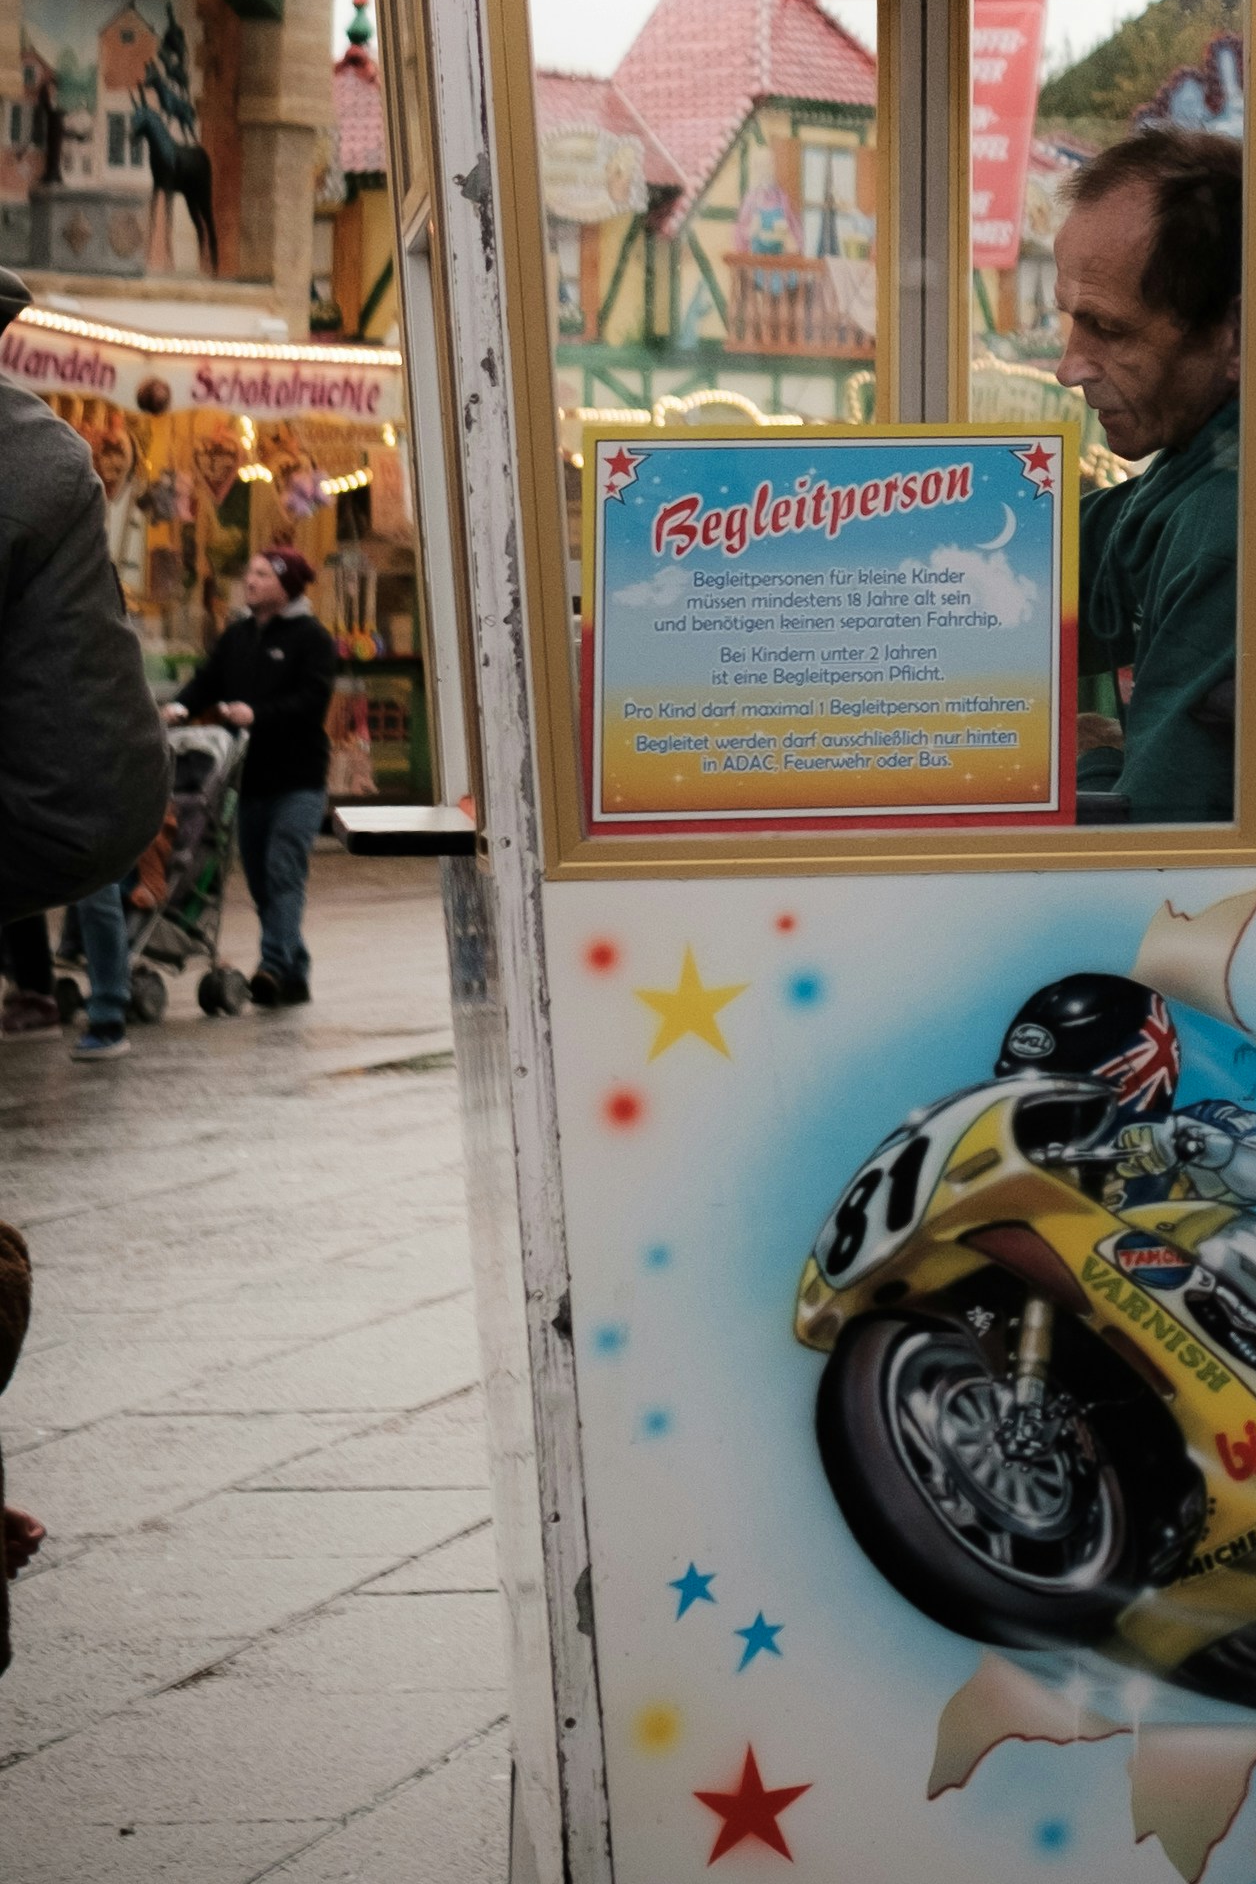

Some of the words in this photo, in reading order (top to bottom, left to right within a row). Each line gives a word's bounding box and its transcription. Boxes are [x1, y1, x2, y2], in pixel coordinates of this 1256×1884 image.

[654, 463, 972, 557] Begleitperson
[693, 571, 825, 588] Begleitpersonen
[830, 570, 853, 585] für
[858, 569, 906, 584] kleine
[912, 569, 965, 584] Kinder
[687, 592, 746, 609] müssen
[751, 591, 842, 608] mindestens
[847, 592, 862, 607] 18
[866, 591, 909, 607] Jahre
[914, 590, 936, 605] alt
[941, 590, 971, 605] sein
[654, 616, 687, 632] und
[692, 615, 774, 635] benötigen
[780, 614, 835, 630] keinen
[840, 614, 922, 633] separaten
[927, 612, 1002, 630] Fahrchip.
[721, 647, 746, 662] Bei
[751, 647, 816, 662] Kindern
[821, 646, 864, 661] unter
[869, 646, 879, 661] 2
[884, 645, 937, 660] Jahren
[712, 669, 728, 685] ist
[732, 669, 767, 684] eine
[773, 668, 884, 686] Begleitperson
[889, 666, 944, 682] Pflicht.
[624, 704, 653, 719] Pro
[659, 703, 696, 718] Kind
[702, 702, 737, 718] darf
[742, 701, 814, 717] maximal
[819, 702, 825, 715] 1
[830, 699, 940, 717] Begleitperson
[945, 698, 1030, 713] mitfahren.
[636, 735, 710, 754] Begleitet
[715, 735, 777, 750] werden
[783, 733, 817, 748] darf
[822, 731, 928, 748] ausschließlich
[934, 732, 962, 746] nur
[967, 729, 1017, 744] hinten
[703, 756, 718, 772] in
[784, 754, 871, 770] Feuerwehr
[877, 754, 914, 768] oder
[919, 752, 952, 767] Bus.
[826, 1135, 931, 1277] 81
[1080, 1255, 1233, 1393] VARNISH
